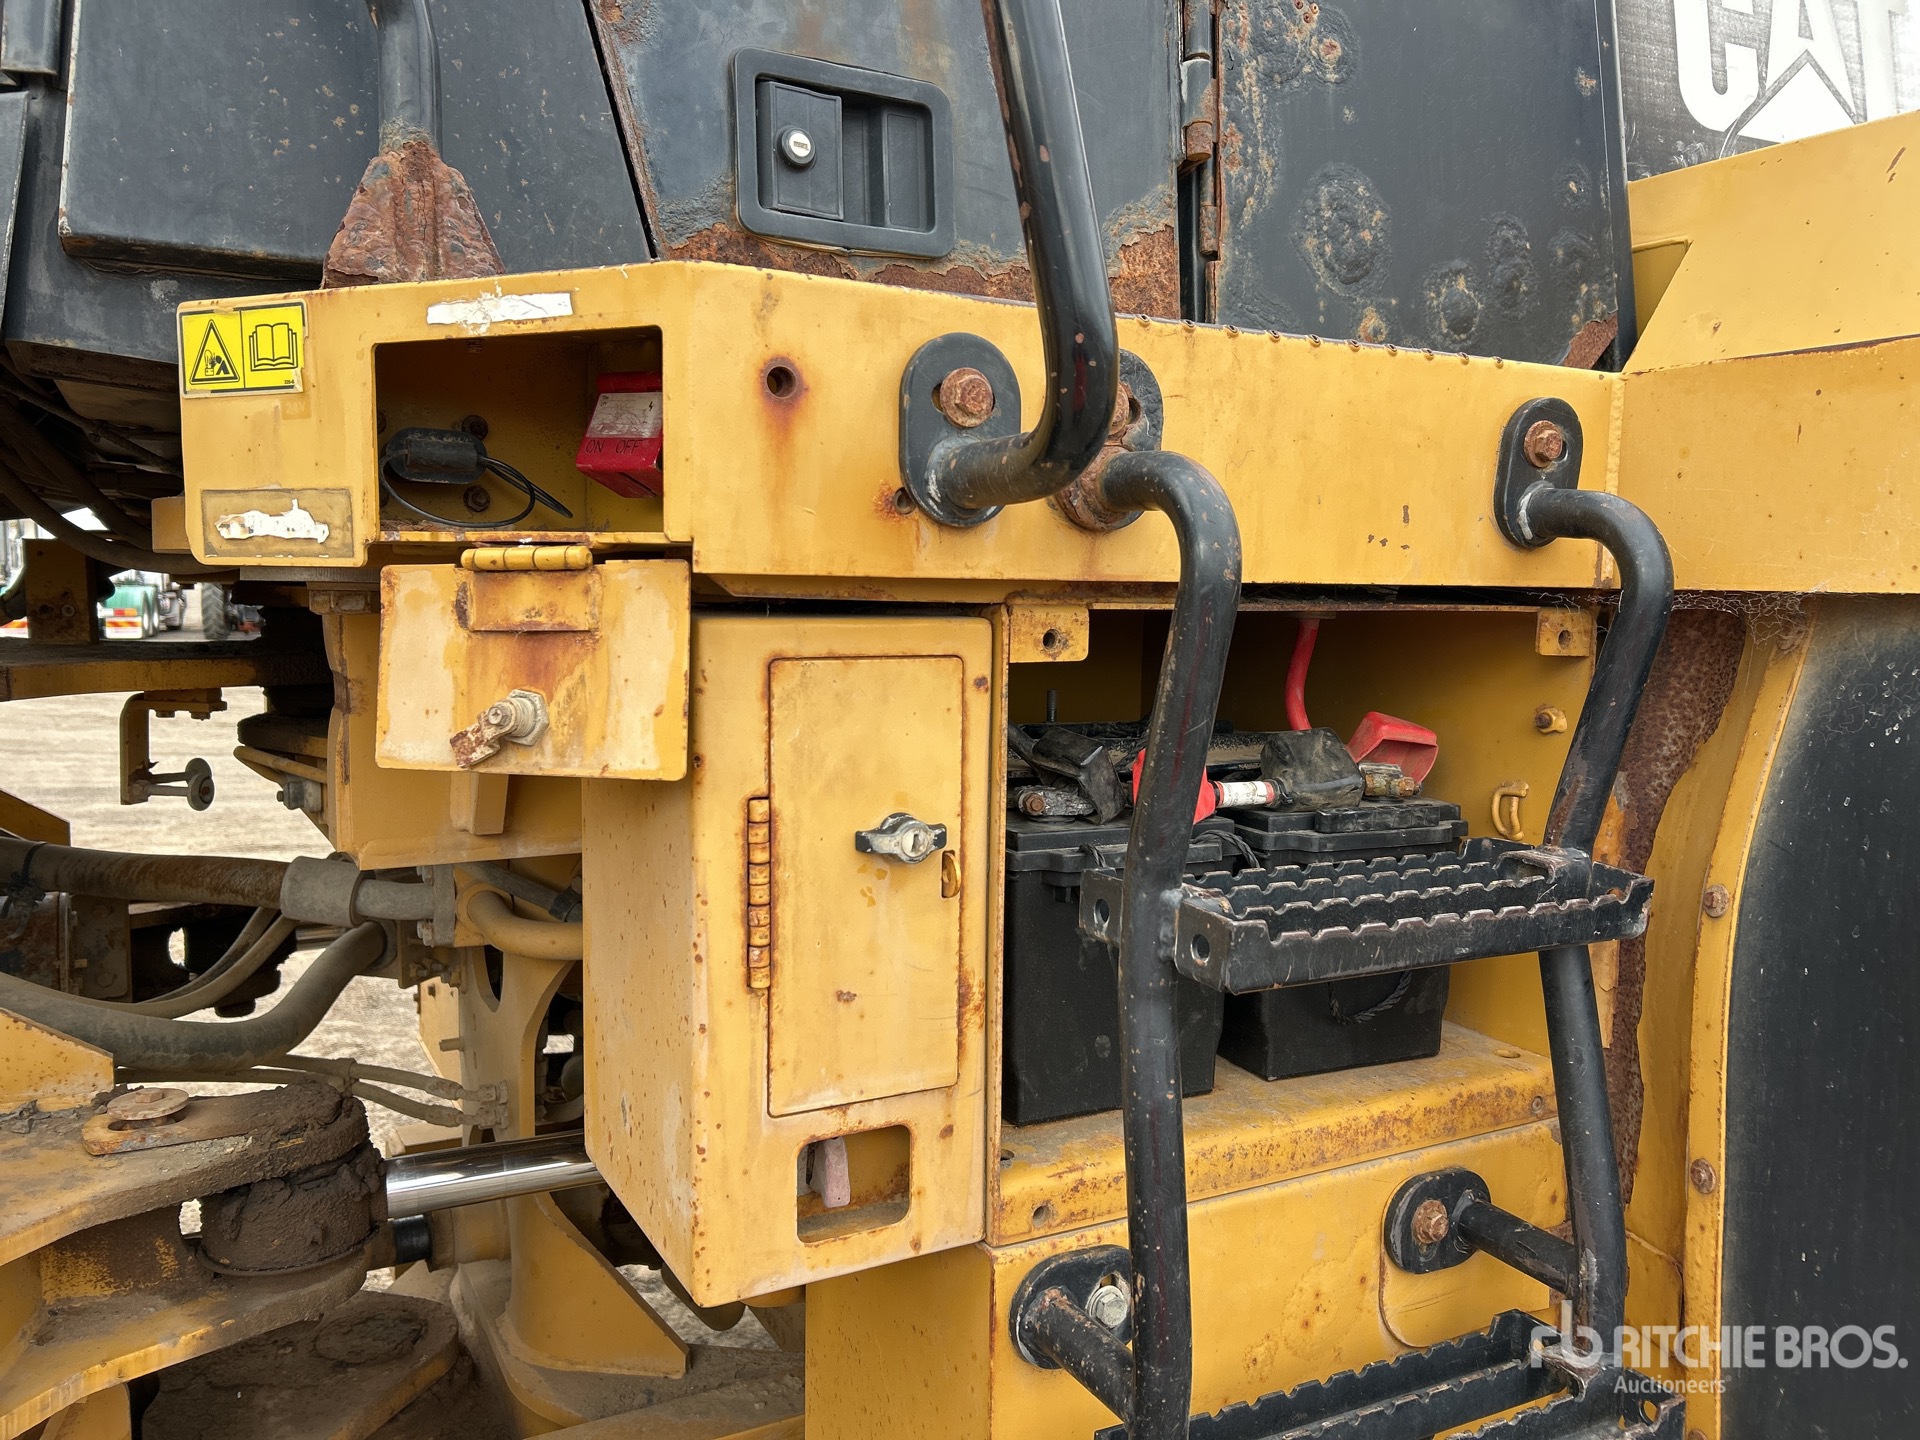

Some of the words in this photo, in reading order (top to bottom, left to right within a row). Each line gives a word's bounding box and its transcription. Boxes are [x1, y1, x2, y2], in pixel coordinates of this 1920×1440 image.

[1673, 0, 1908, 133] CAT
[585, 440, 605, 454] ON
[615, 439, 643, 454] OFF
